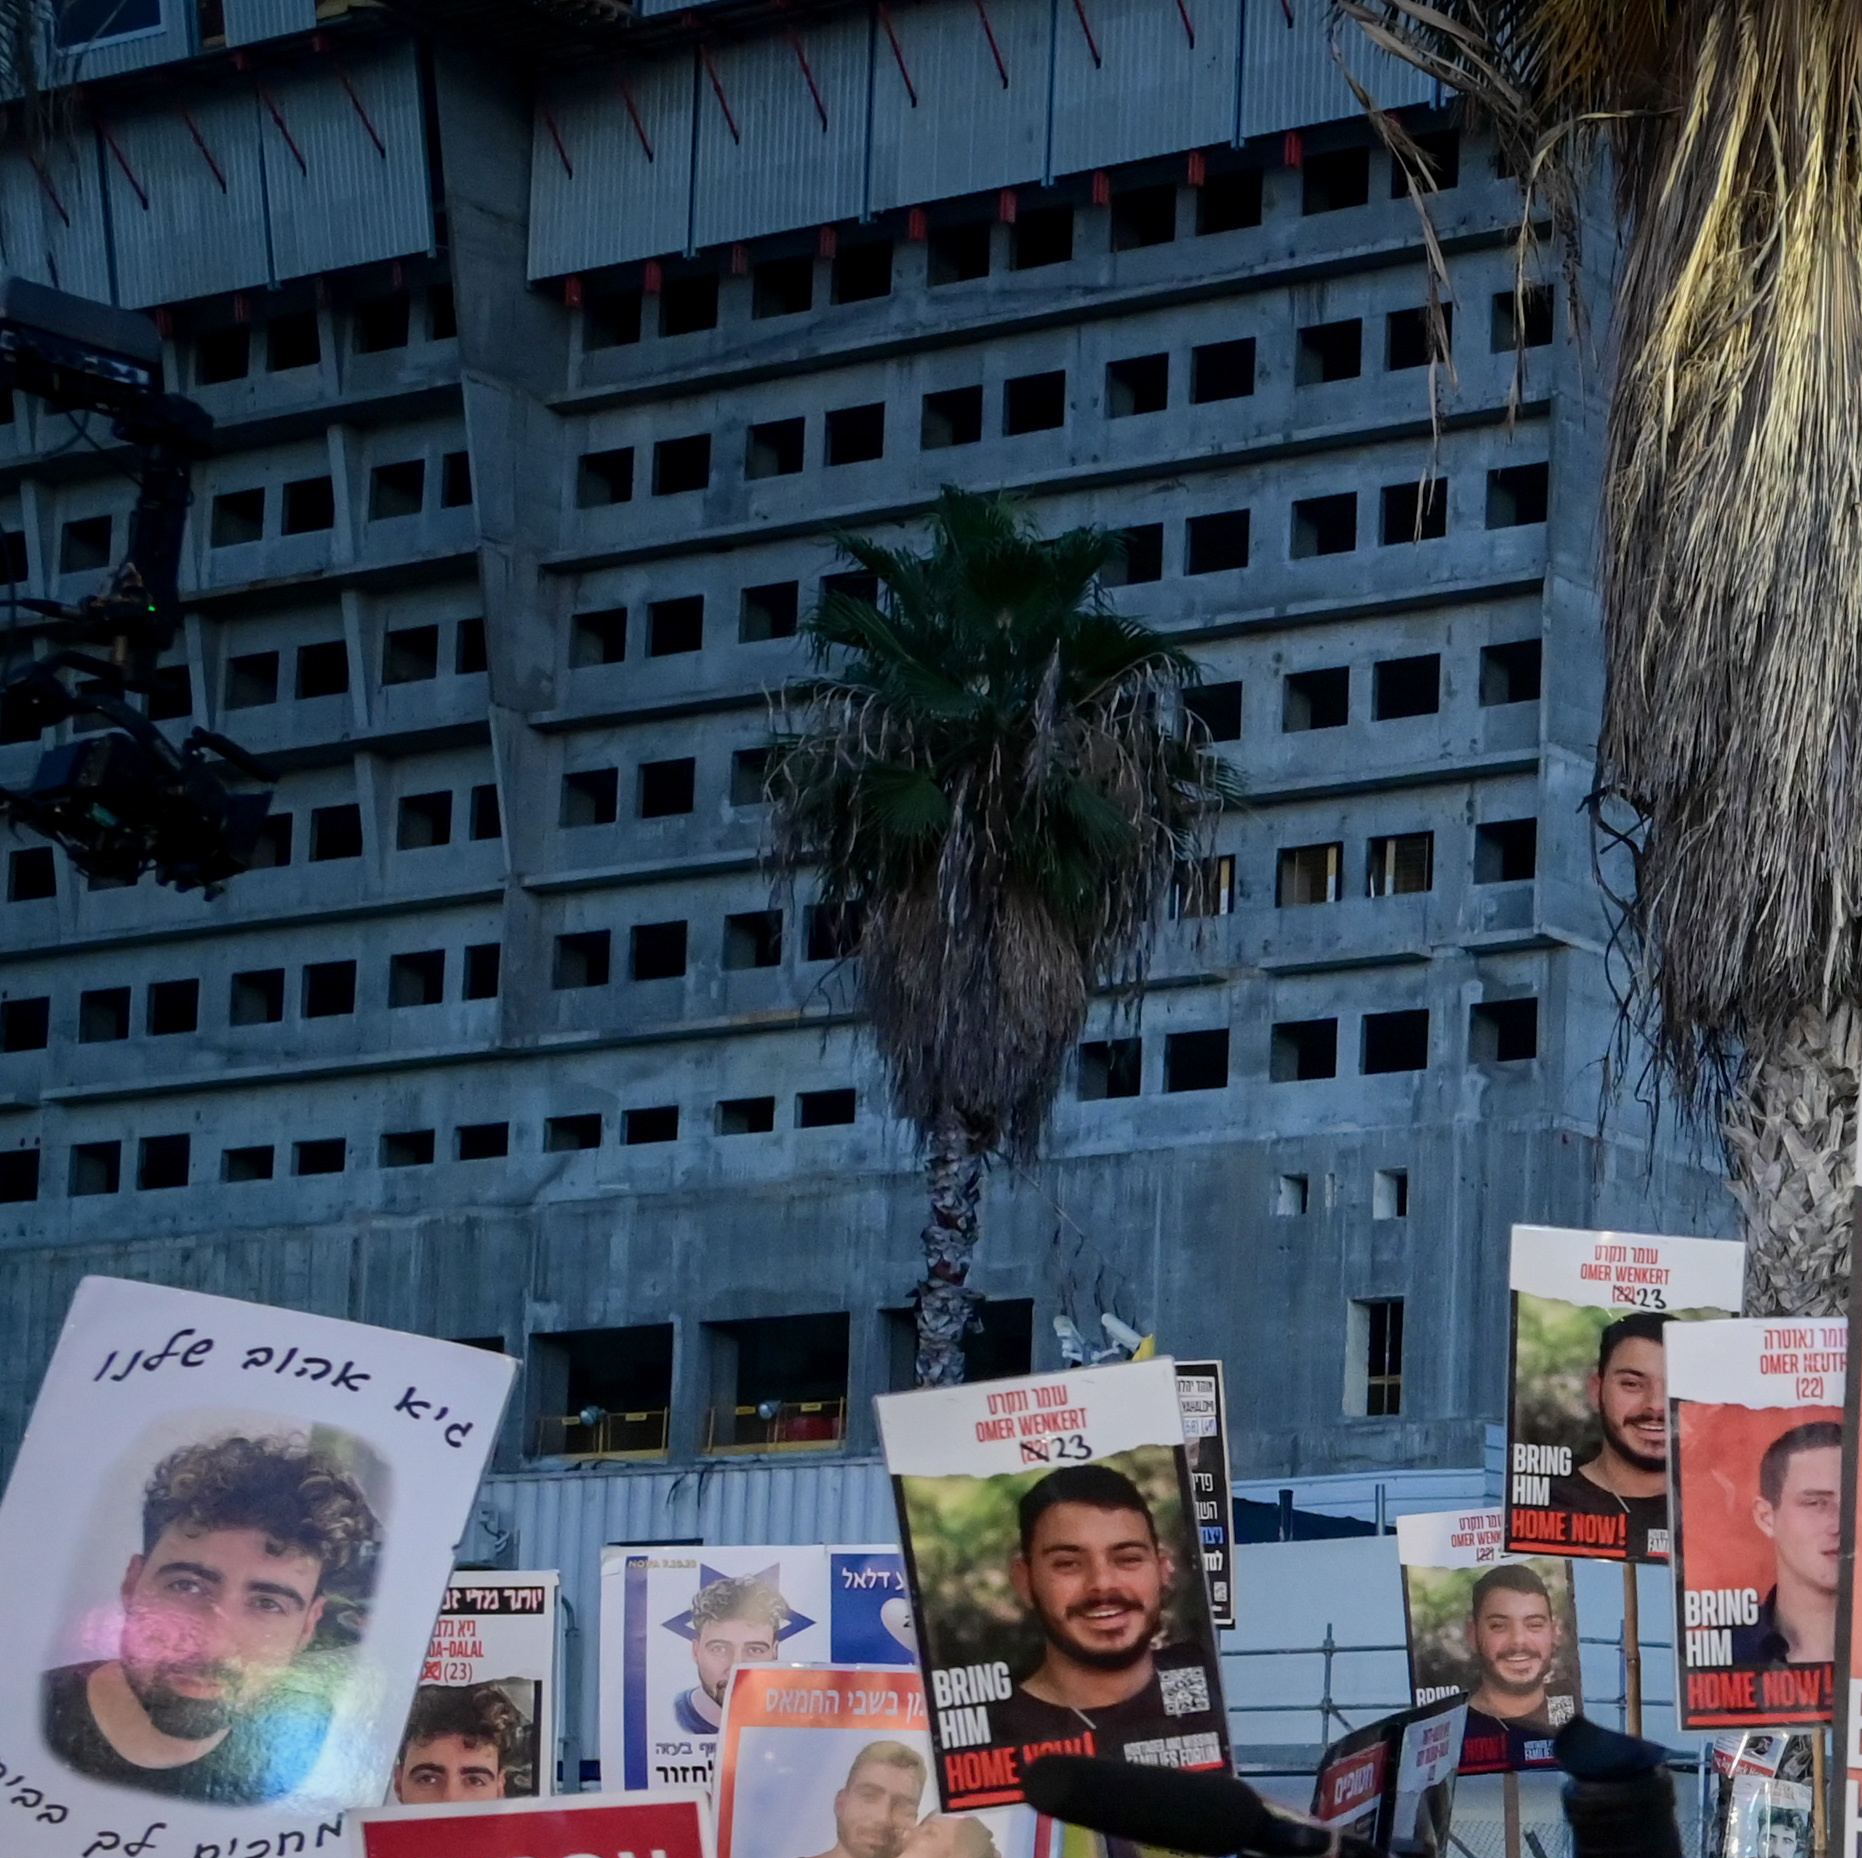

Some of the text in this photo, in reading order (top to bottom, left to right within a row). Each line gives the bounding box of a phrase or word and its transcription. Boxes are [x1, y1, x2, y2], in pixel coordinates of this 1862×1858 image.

[1580, 1264, 1670, 1286] OMER WENKERT
[1637, 1287, 1667, 1310] 23
[1760, 1354, 1799, 1375] OMER
[94, 1327, 475, 1450] גיא אהוב שלנו
[1037, 1385, 1068, 1407] עומר
[1796, 1377, 1824, 1400] (22)
[975, 1407, 1088, 1443] OMER WENKERT
[1051, 1434, 1093, 1461] 23
[1513, 1442, 1572, 1476] BRING
[1513, 1475, 1550, 1507] HIM
[1451, 1532, 1474, 1549] OMER
[1511, 1510, 1628, 1546] HOME NOW!
[466, 1589, 542, 1611] יותר מדי
[1684, 1588, 1758, 1627] BRING
[1686, 1628, 1733, 1667] HIM
[444, 1662, 472, 1683] (23)
[931, 1661, 1012, 1710] BRING
[766, 1688, 898, 1716] בשבי החמאס
[1687, 1670, 1834, 1710] HOME NOW!
[939, 1706, 991, 1749] HIM
[945, 1745, 1021, 1795] HOME
